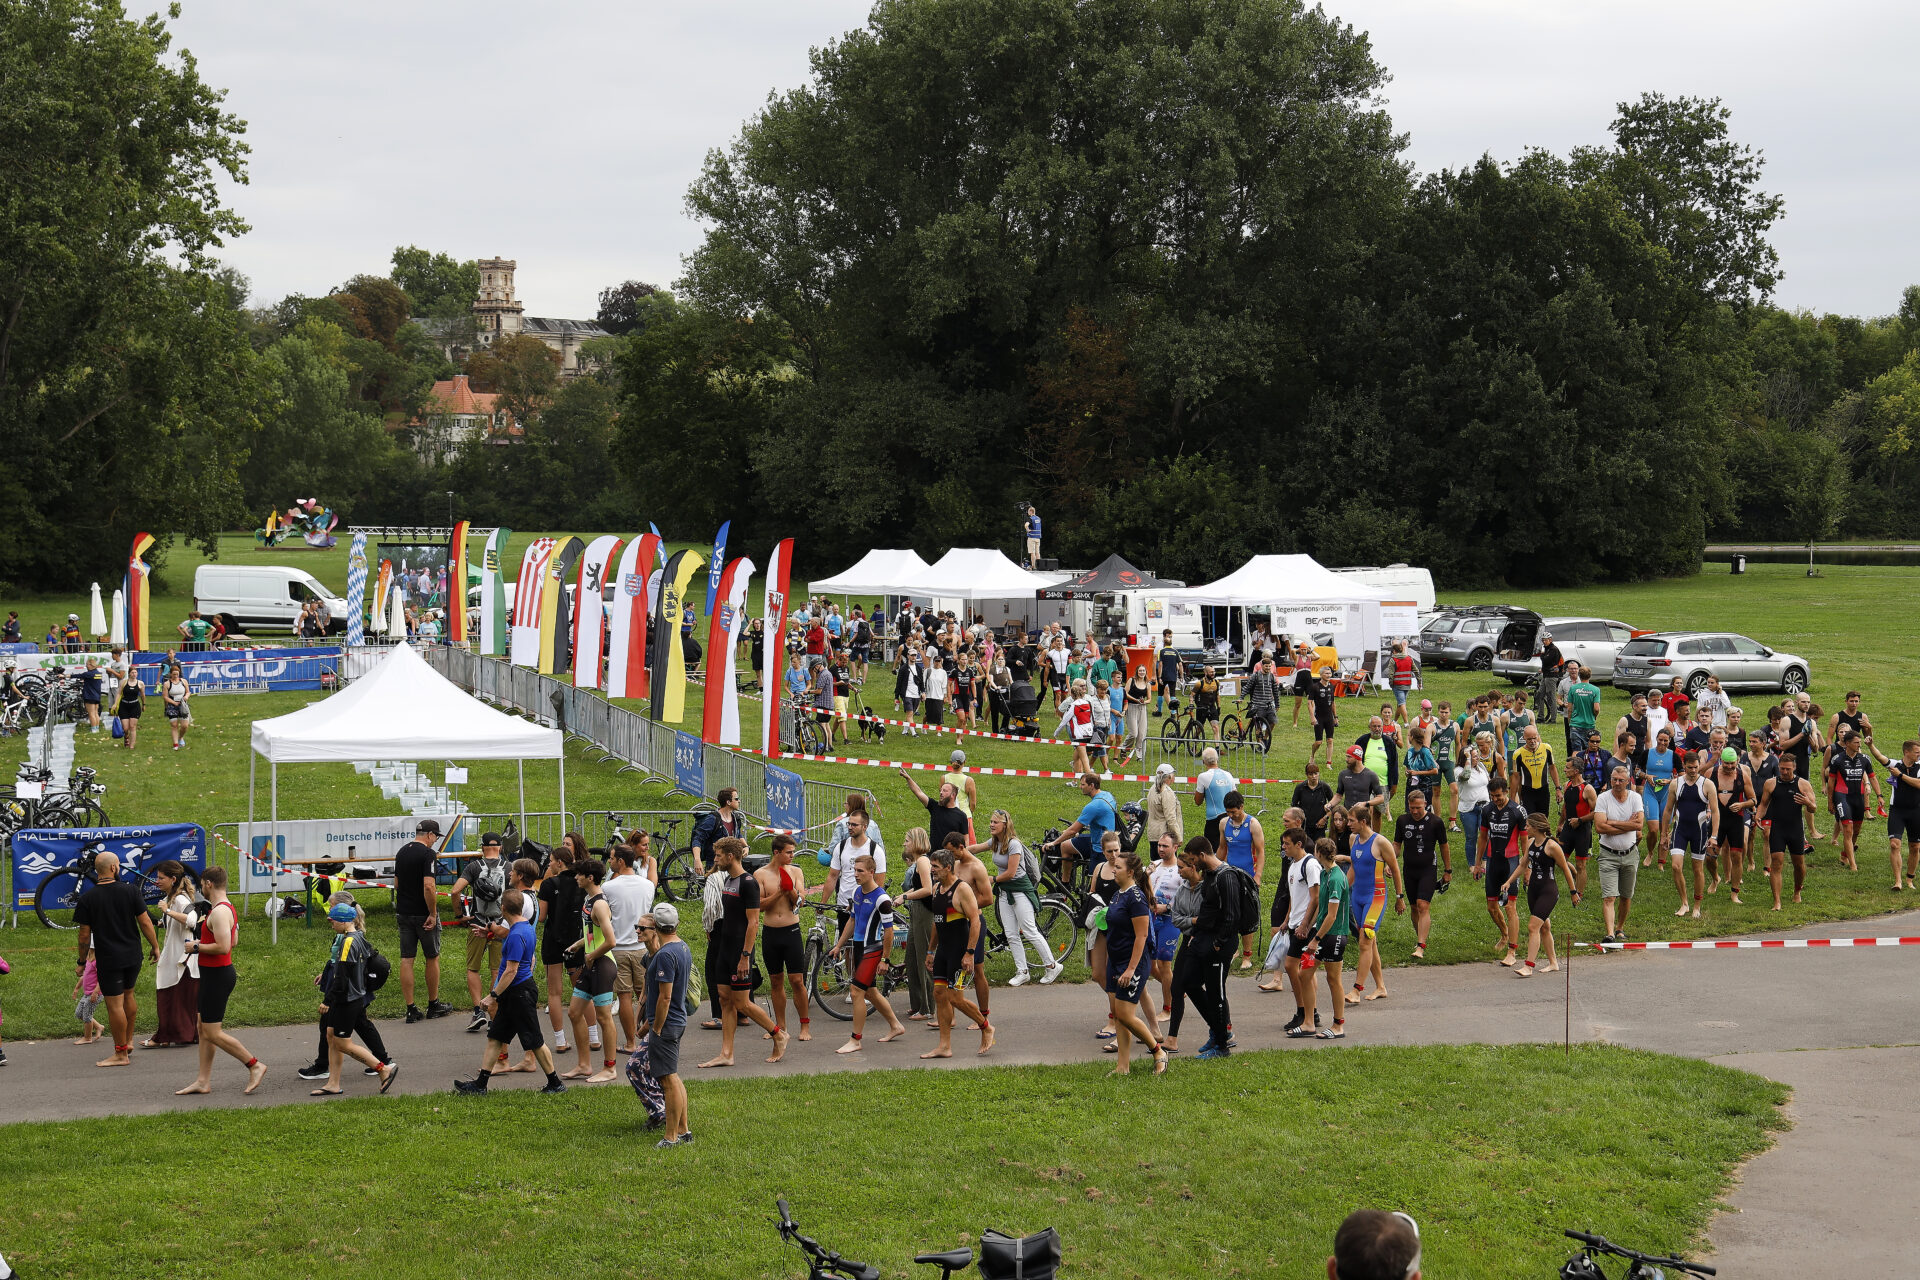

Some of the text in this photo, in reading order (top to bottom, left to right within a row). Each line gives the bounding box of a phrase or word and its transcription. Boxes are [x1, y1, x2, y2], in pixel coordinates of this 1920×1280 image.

[17, 829, 153, 842] HALLE TRIATHLON
[326, 832, 371, 843] Deutsche
